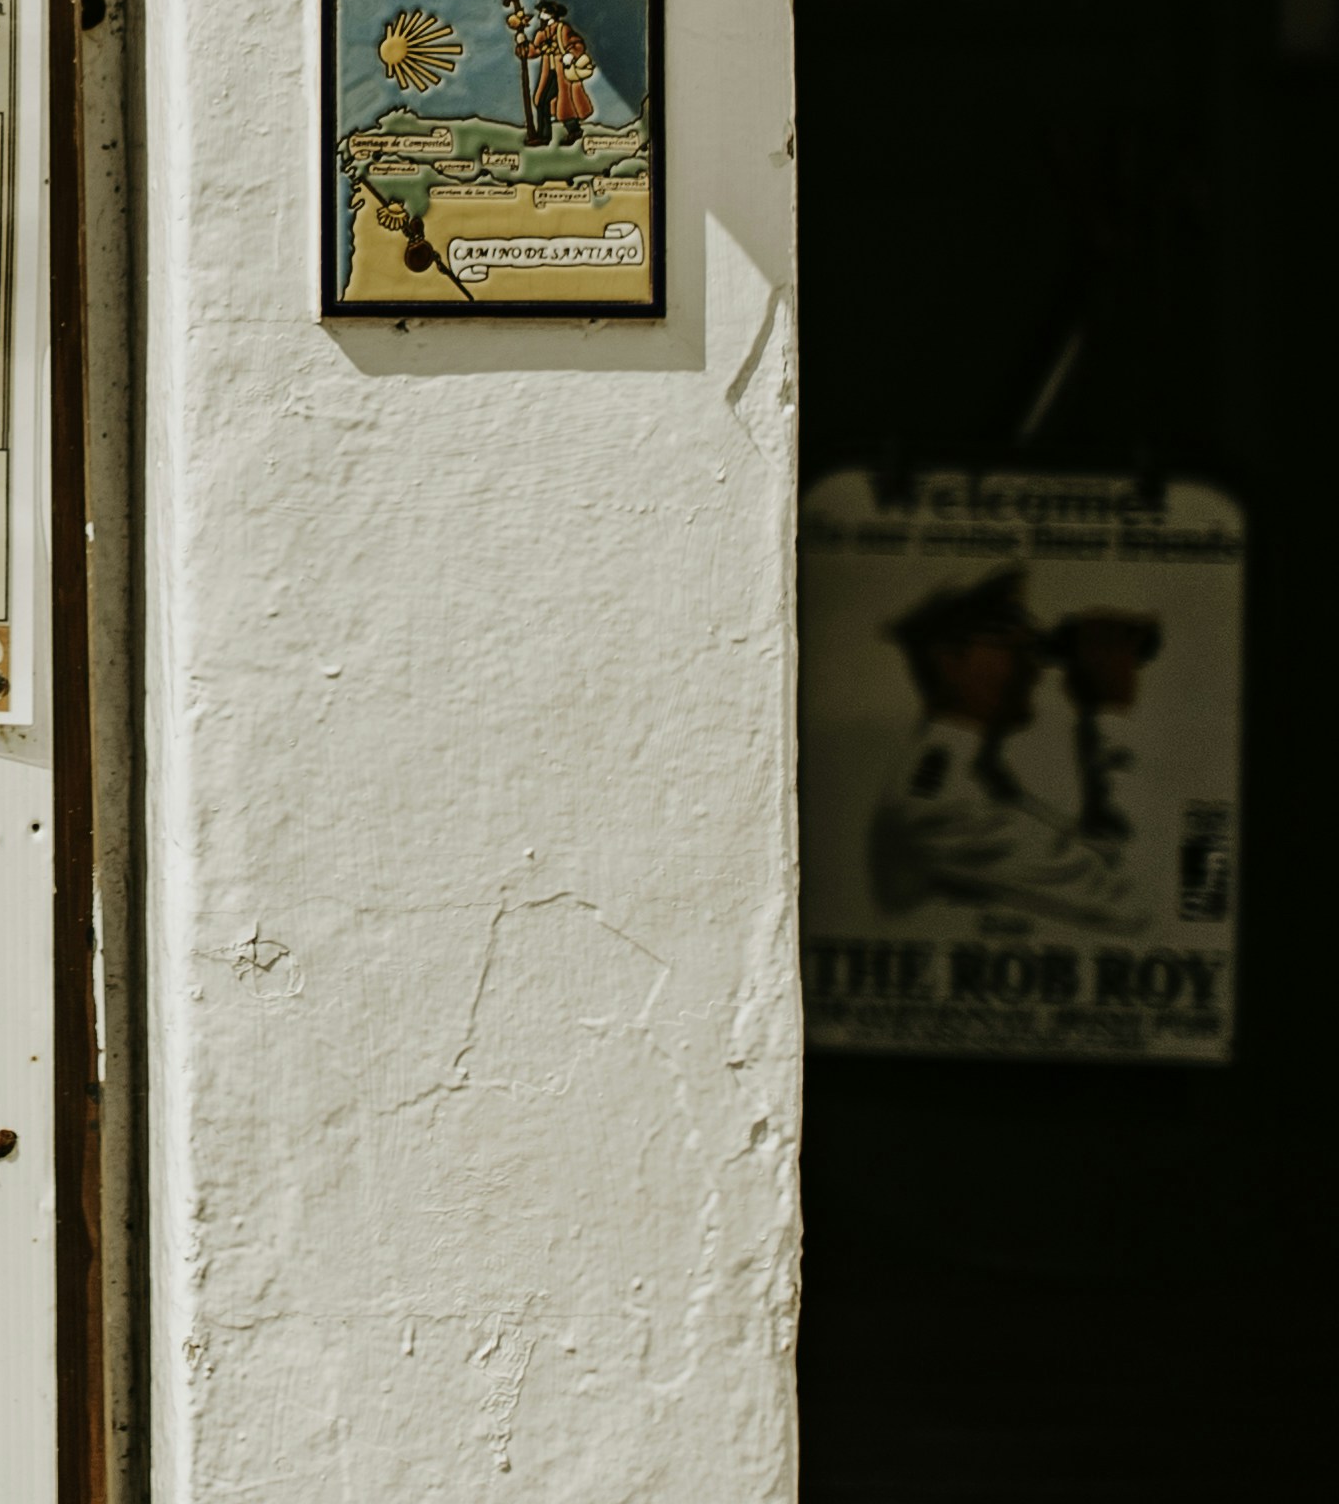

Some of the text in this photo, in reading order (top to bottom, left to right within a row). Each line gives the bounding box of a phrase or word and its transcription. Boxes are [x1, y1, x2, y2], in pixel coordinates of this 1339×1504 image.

[454, 247, 639, 263] CAMINO DE SANTIAGO
[810, 937, 1223, 1009] THE ROB ROY
